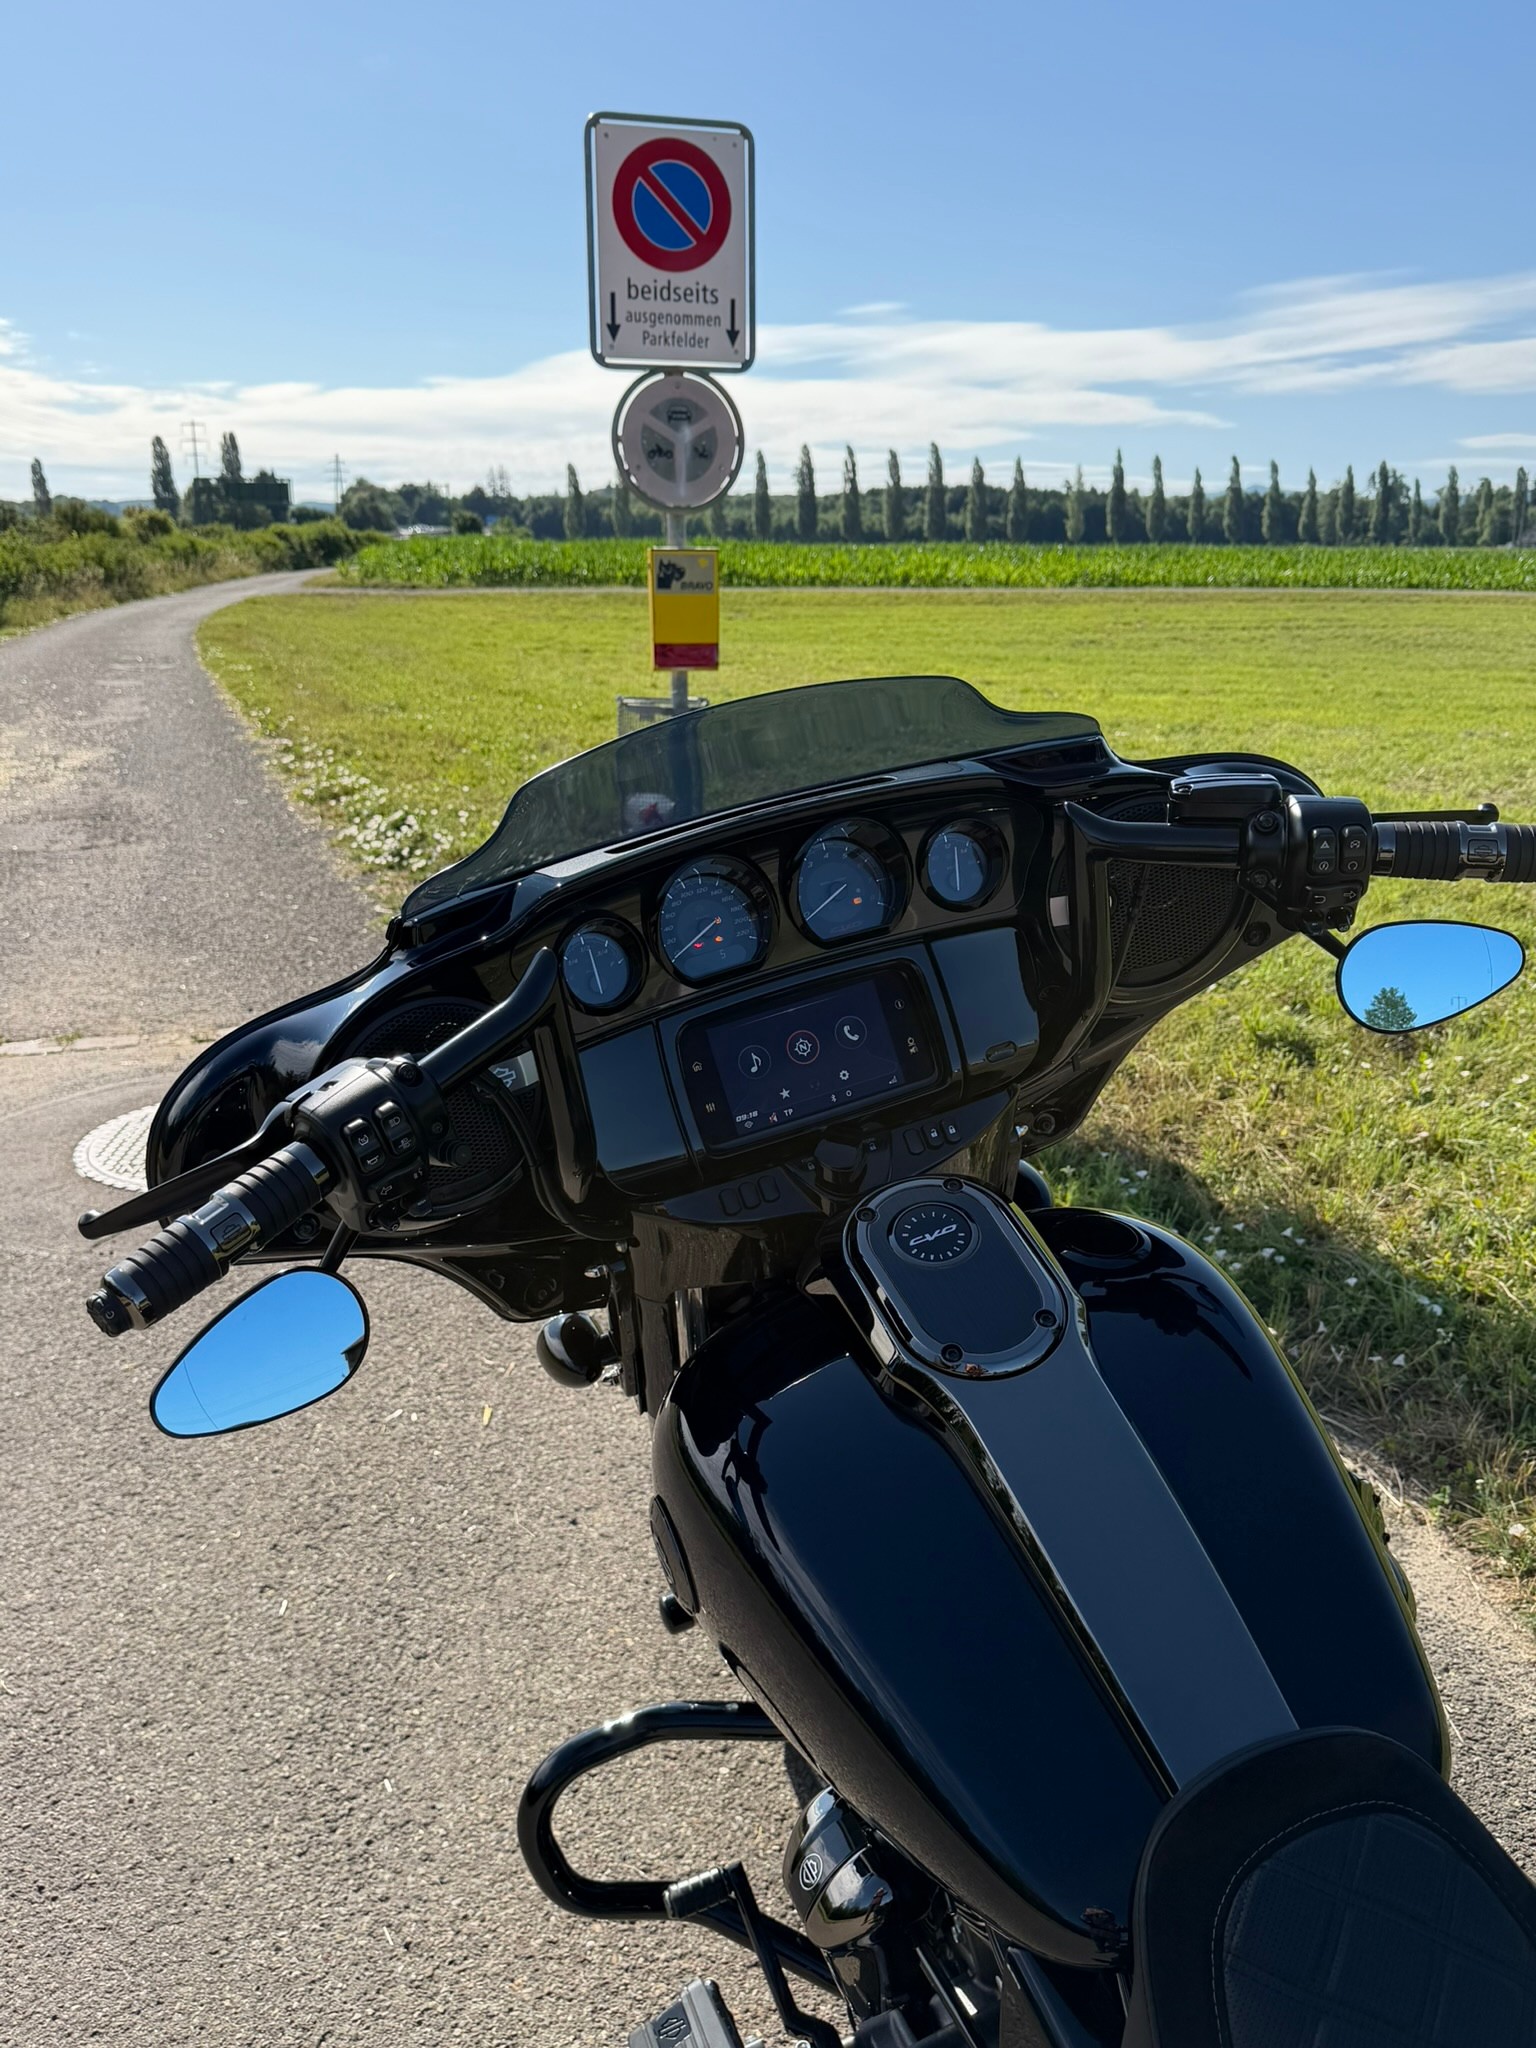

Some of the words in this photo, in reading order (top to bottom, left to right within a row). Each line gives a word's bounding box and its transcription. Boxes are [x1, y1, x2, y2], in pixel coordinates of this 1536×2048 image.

[627, 277, 719, 304] beidseits
[625, 309, 722, 328] ausgenommen
[642, 331, 710, 349] Parkfelder
